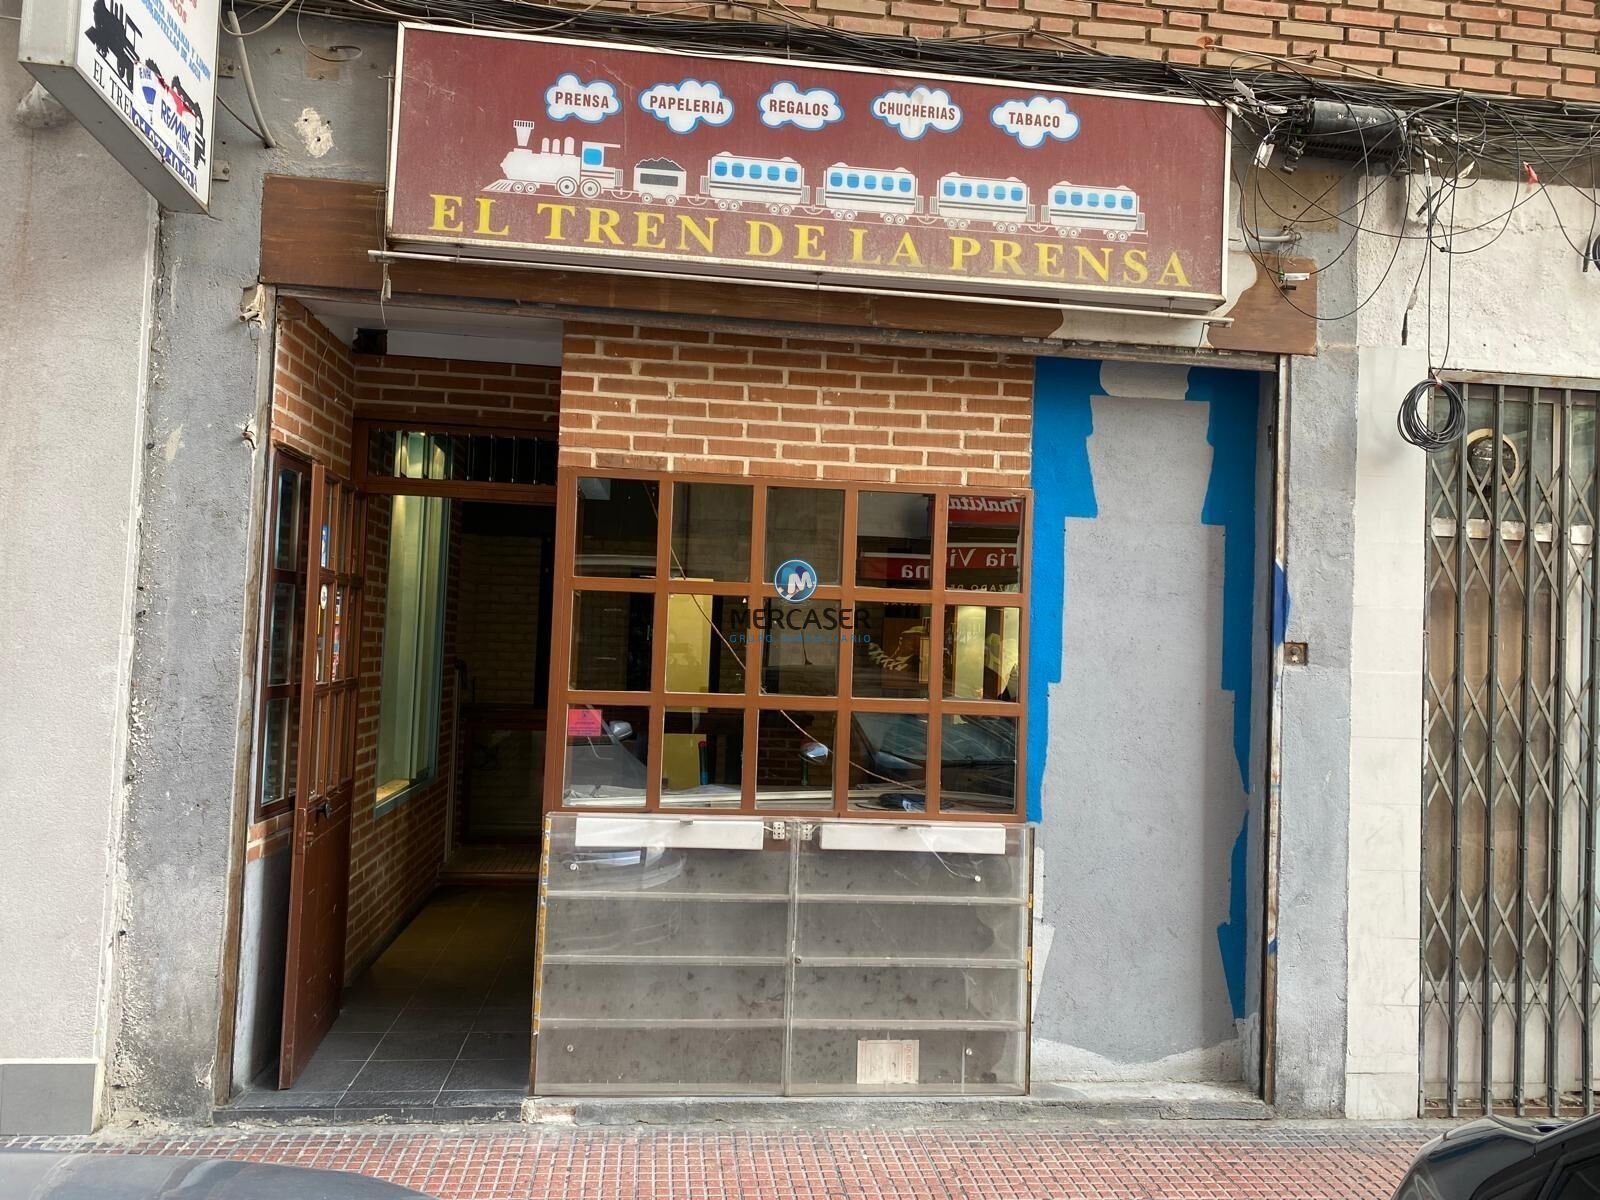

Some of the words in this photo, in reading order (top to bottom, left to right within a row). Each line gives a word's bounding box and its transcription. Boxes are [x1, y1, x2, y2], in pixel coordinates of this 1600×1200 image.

[93, 58, 105, 89] EL
[554, 91, 609, 109] PRENSA
[650, 96, 725, 115] PAPELERIA
[769, 99, 829, 117] REGALOS
[879, 102, 956, 121] CHUCHERIAS
[1009, 112, 1060, 129] TABACO
[161, 98, 190, 151] RE/MAX
[429, 193, 511, 238] EL
[536, 201, 718, 254] TREN
[745, 219, 828, 261] DE
[849, 227, 926, 268] LA
[949, 235, 1192, 288] PRENSA
